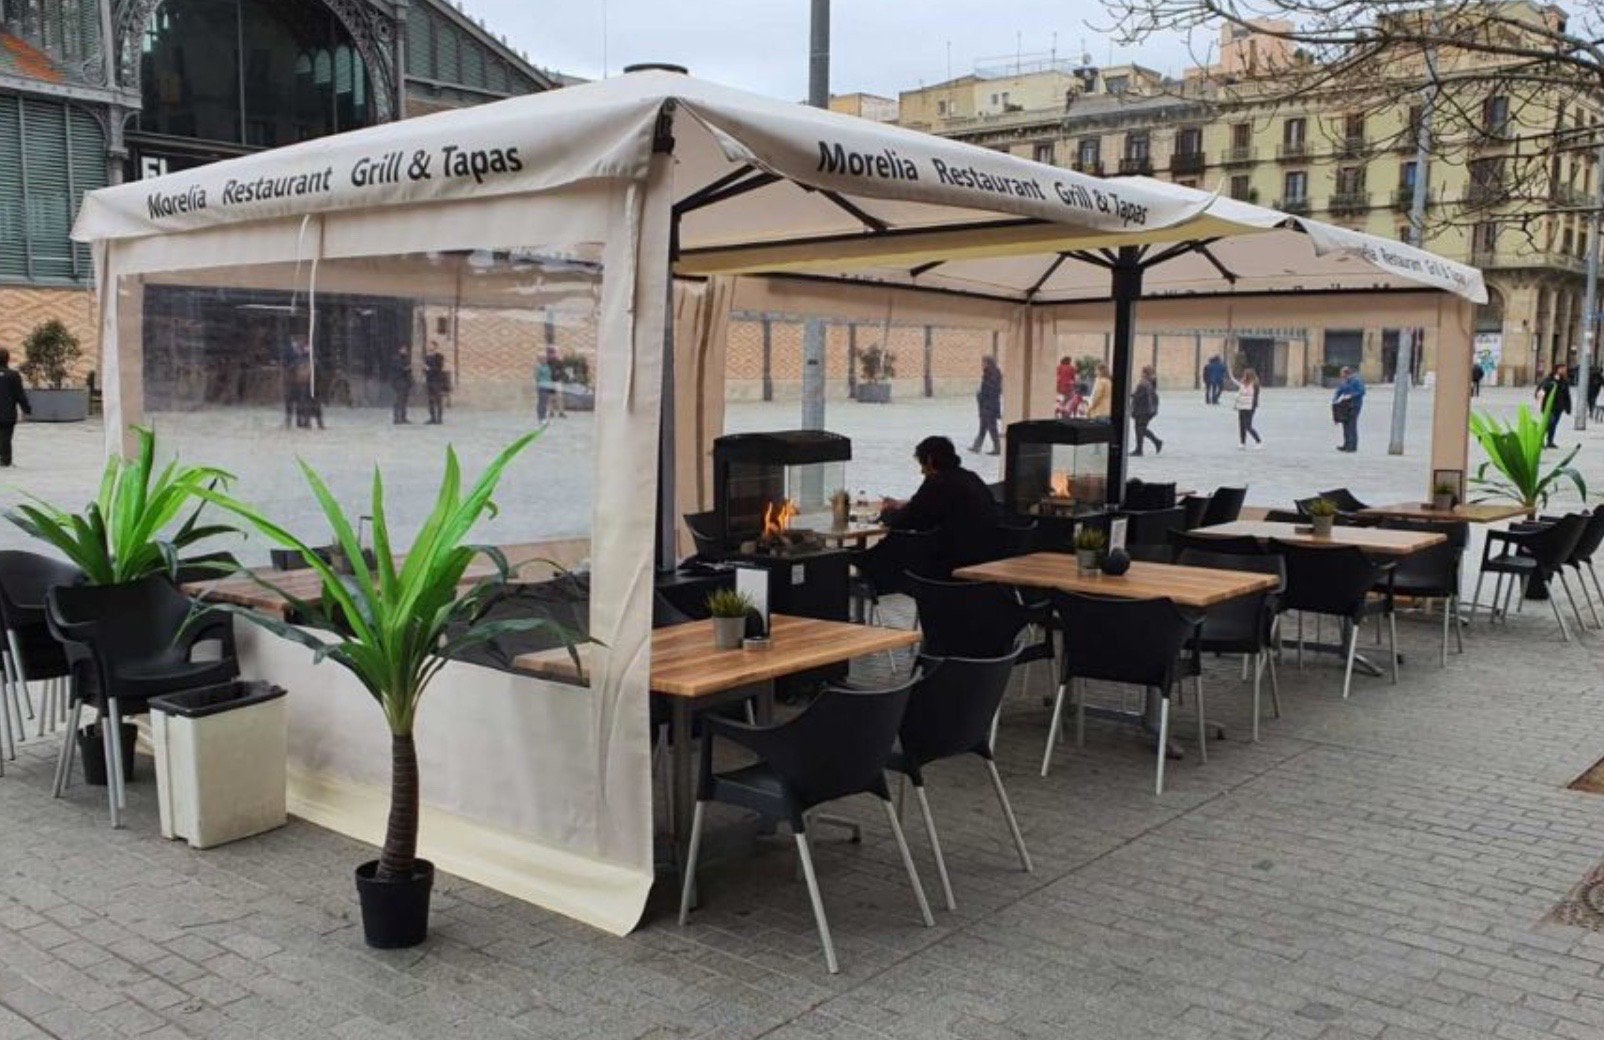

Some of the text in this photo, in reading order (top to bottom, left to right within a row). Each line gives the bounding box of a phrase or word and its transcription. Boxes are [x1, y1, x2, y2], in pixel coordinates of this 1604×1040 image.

[147, 145, 523, 219] Morelia Restaurant Grill & Tapas
[817, 140, 919, 181] Morelia
[931, 157, 1046, 200] Restaurant
[1054, 181, 1093, 210] Grill
[1108, 191, 1148, 228] Tapas
